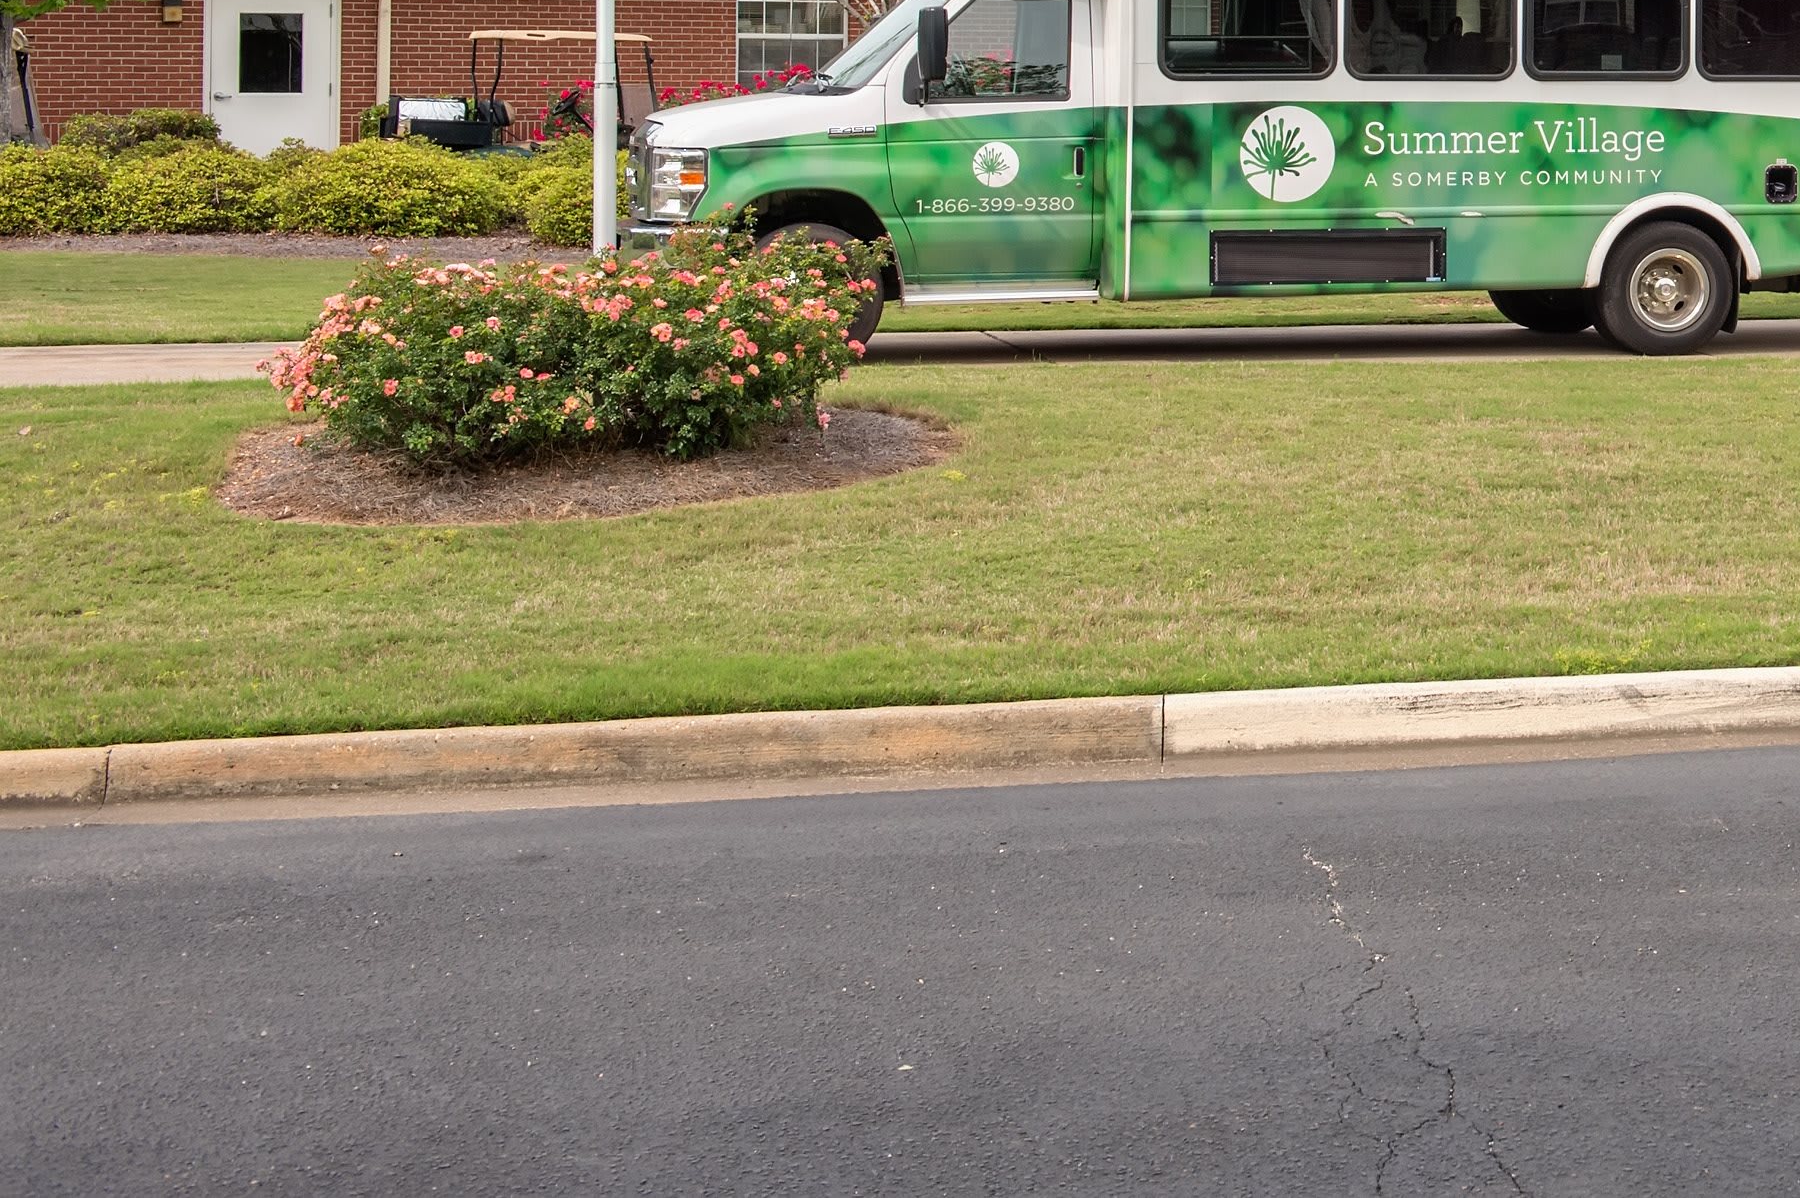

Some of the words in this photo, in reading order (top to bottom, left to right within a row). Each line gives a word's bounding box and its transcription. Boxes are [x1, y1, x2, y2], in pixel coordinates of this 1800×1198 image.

[1363, 121, 1524, 155] Summer
[1533, 117, 1665, 161] Village
[1364, 172, 1378, 187] A
[1392, 171, 1507, 187] SOMERBY
[1520, 169, 1663, 185] COMMUNITY
[915, 196, 1075, 214] 1-866-399-9380
